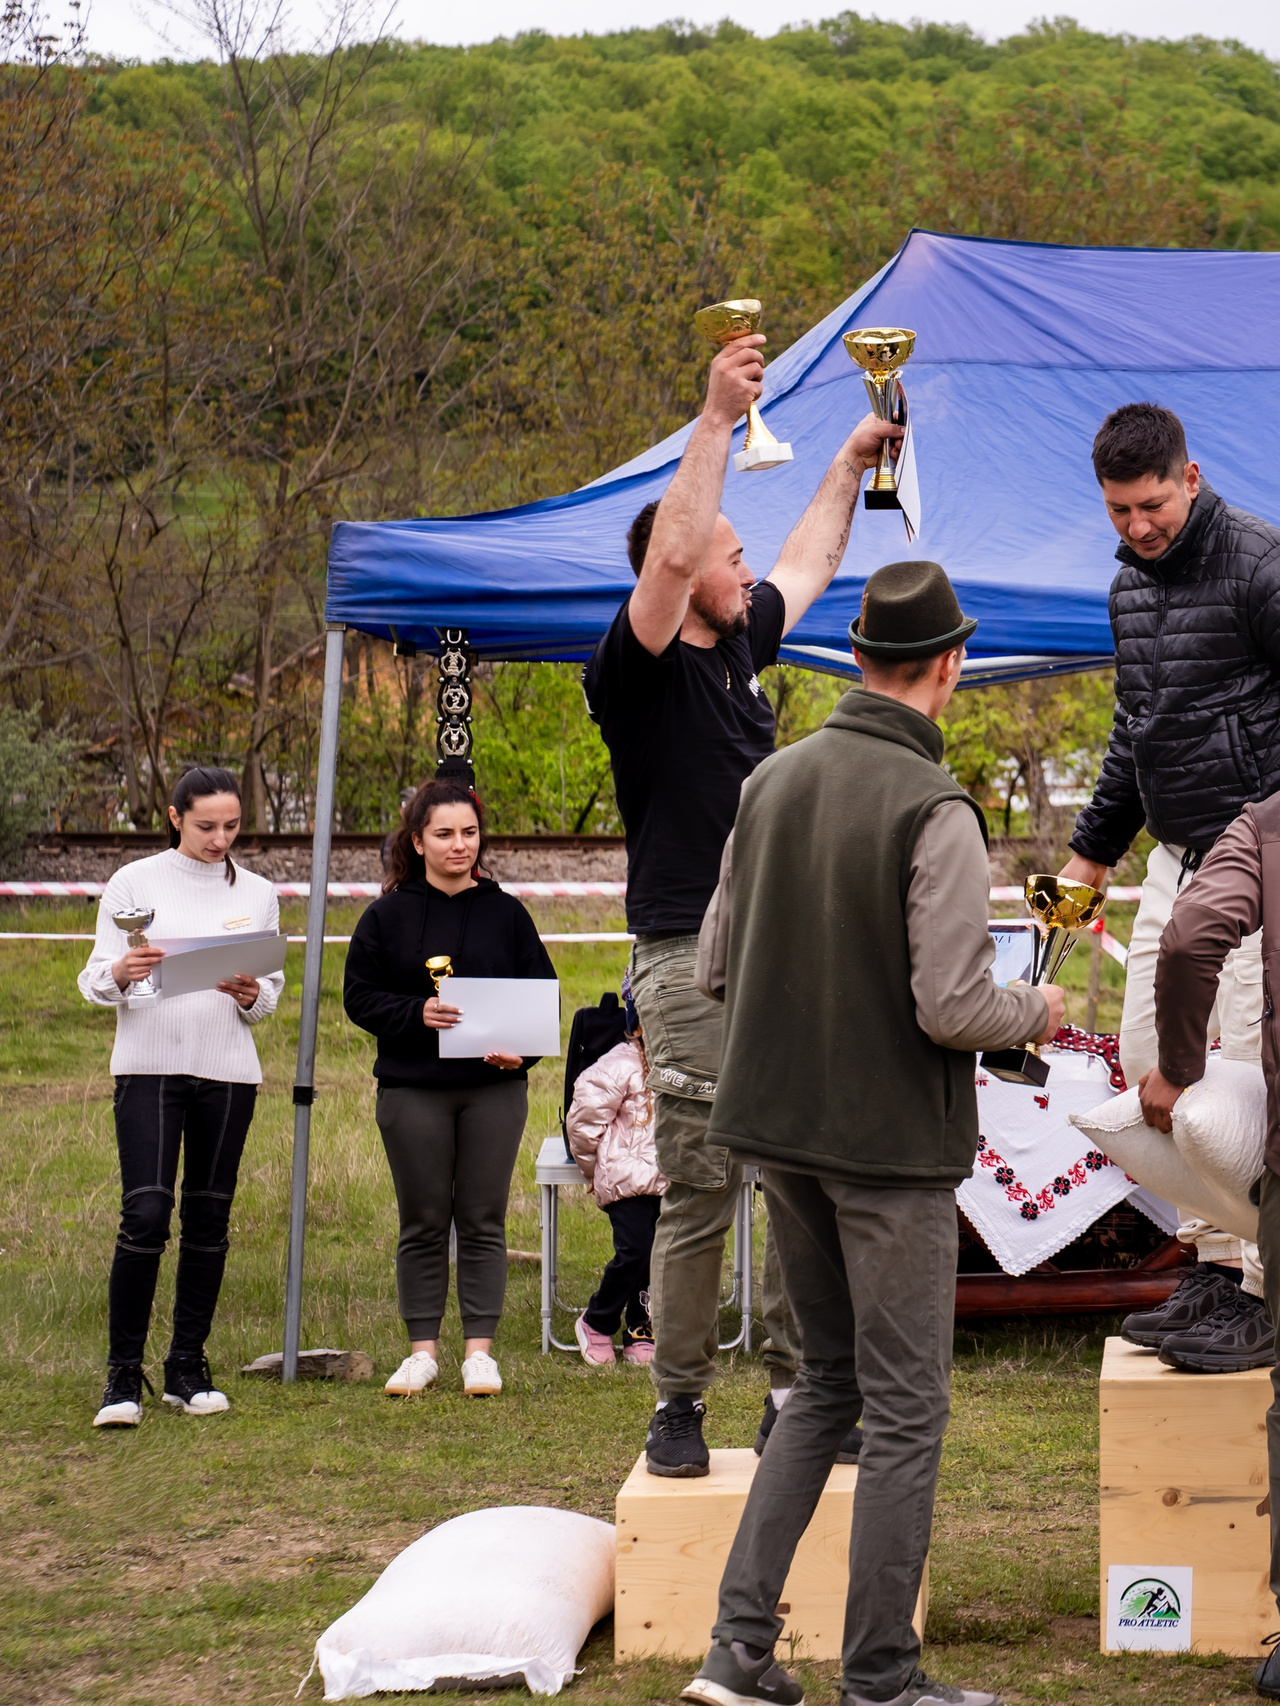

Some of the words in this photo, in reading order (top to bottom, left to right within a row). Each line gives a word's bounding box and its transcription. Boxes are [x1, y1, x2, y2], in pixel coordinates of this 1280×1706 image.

[826, 553, 839, 566] My
[660, 1068, 688, 1088] WE
[698, 1081, 718, 1094] A
[1118, 1618, 1138, 1627] PRO
[1137, 1618, 1179, 1628] ATLETIC
